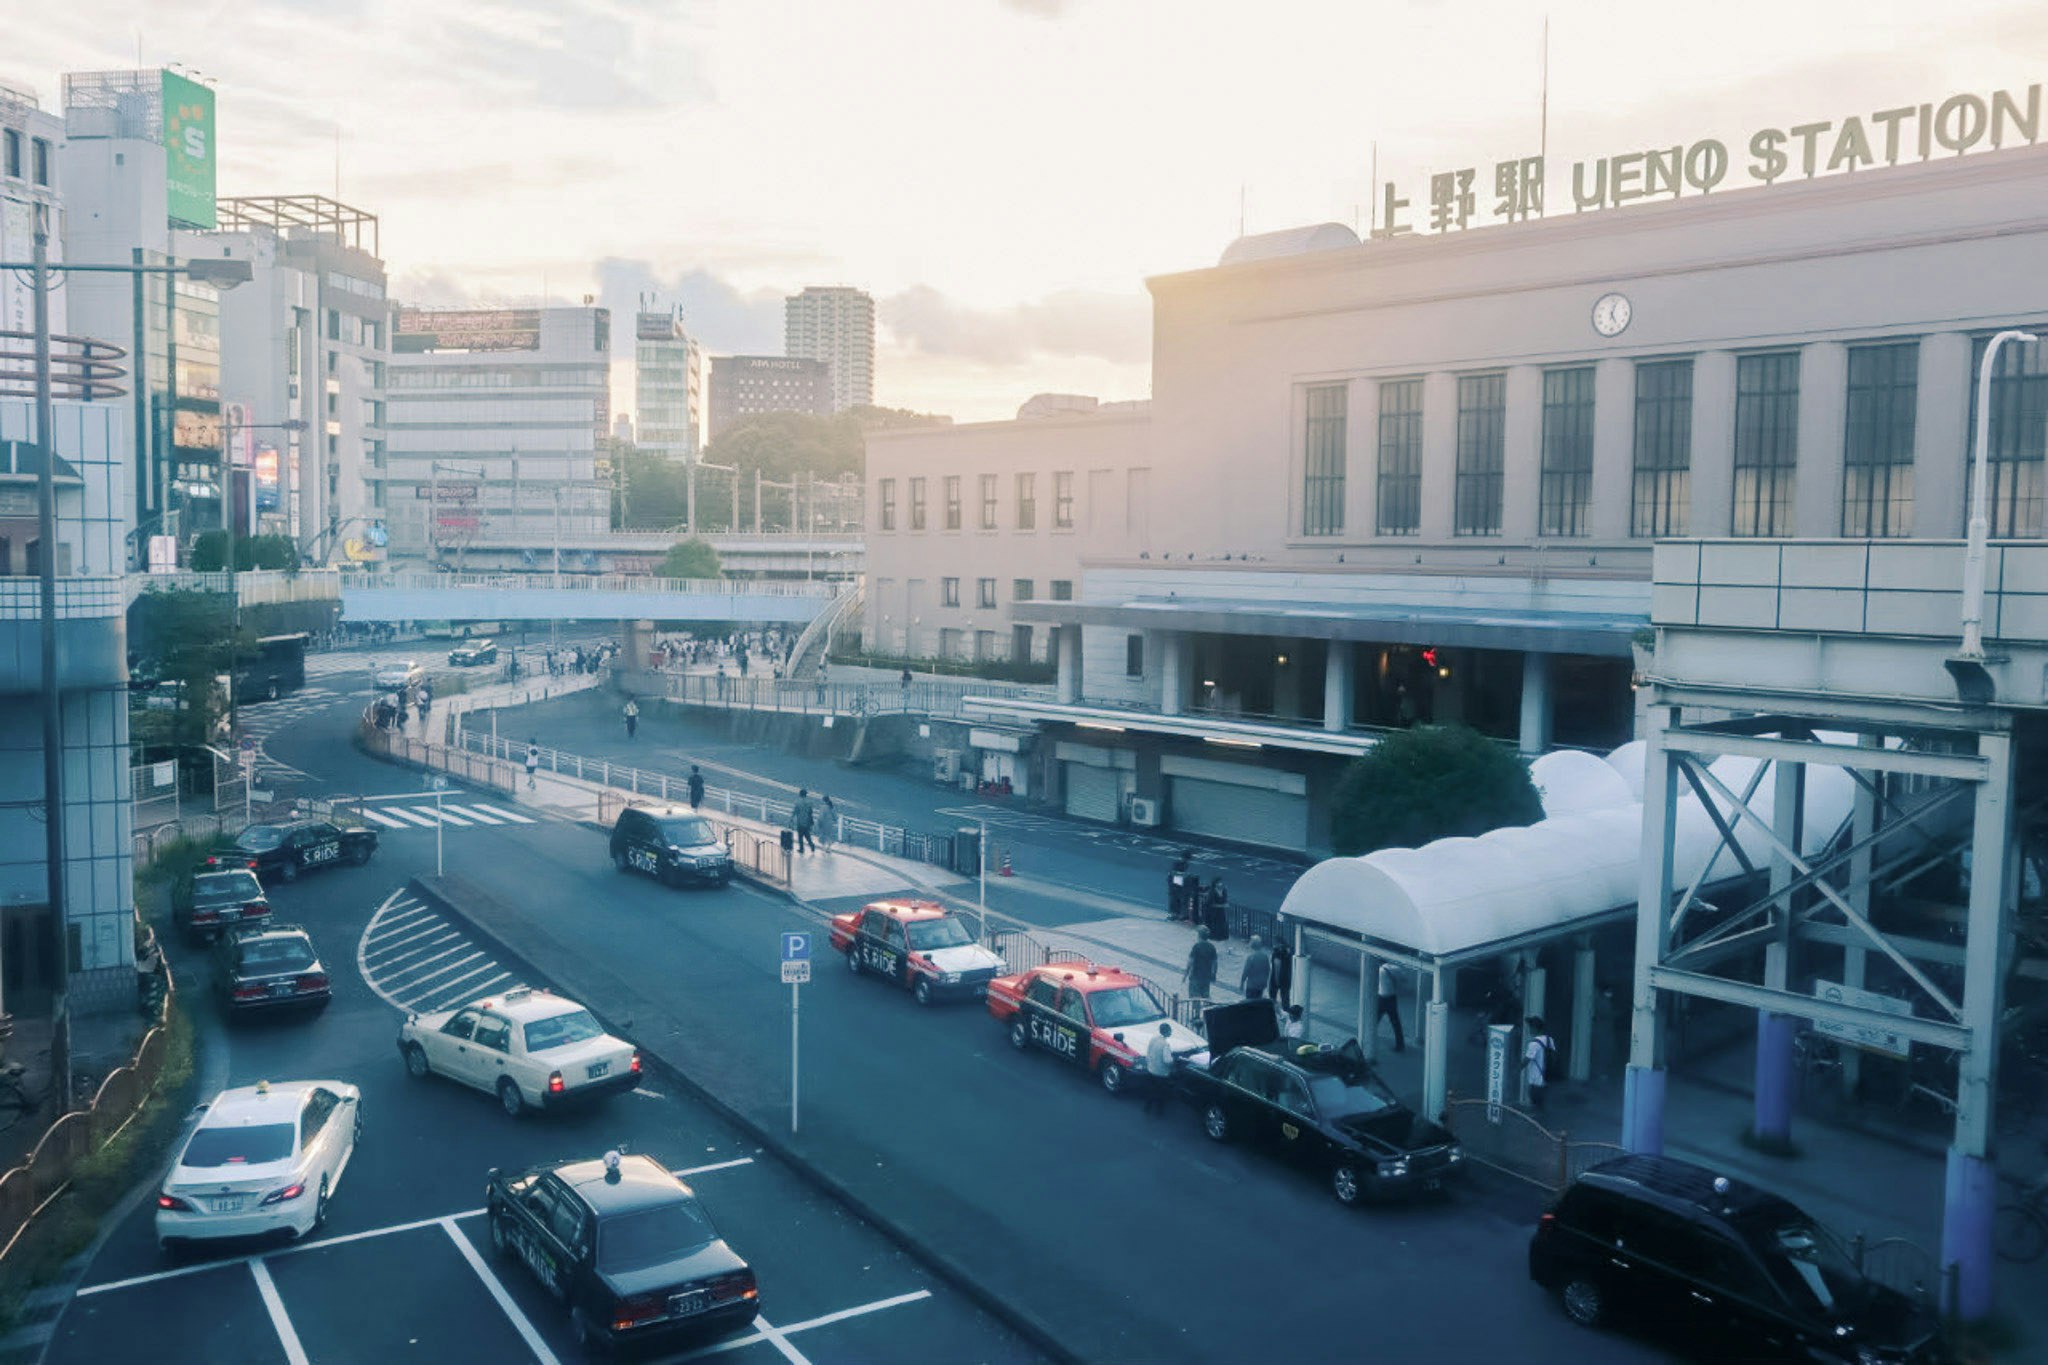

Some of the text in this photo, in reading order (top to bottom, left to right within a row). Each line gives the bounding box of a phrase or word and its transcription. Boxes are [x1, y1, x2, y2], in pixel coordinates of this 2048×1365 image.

[184, 126, 205, 159] S
[1371, 84, 2042, 236] 上野駅 UENO STATION
[771, 361, 801, 370] HOTEL
[789, 936, 805, 958] P
[1031, 1021, 1076, 1057] S.RIDE
